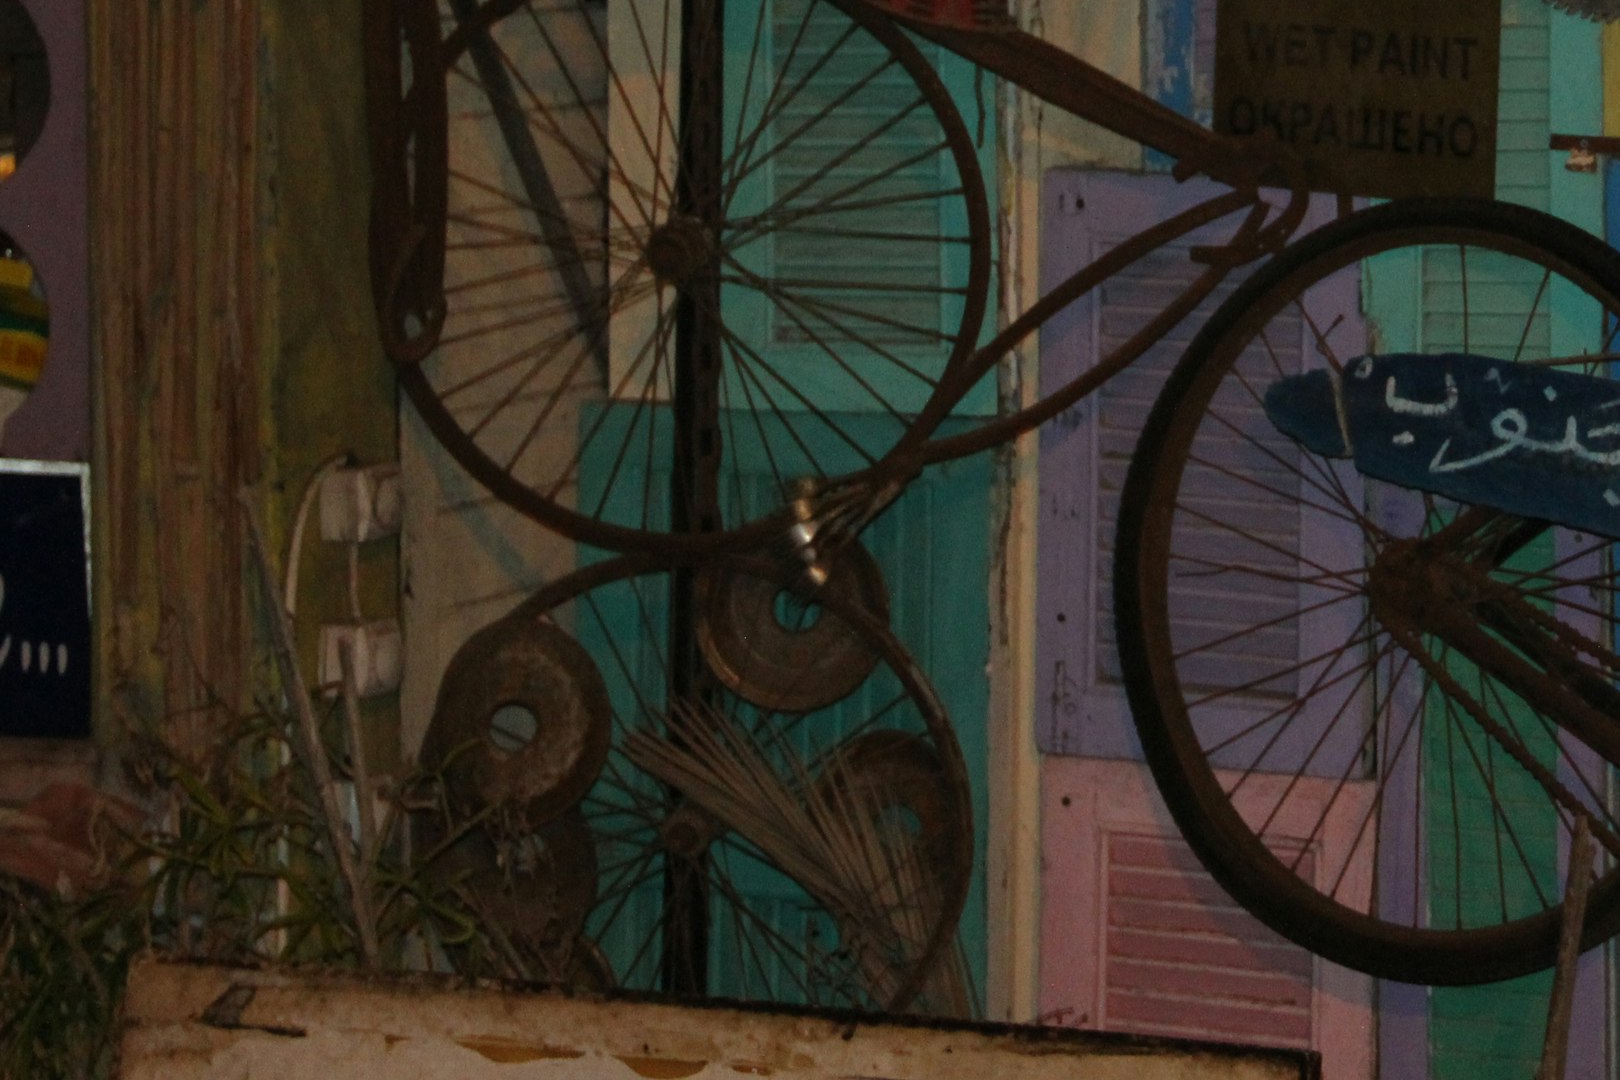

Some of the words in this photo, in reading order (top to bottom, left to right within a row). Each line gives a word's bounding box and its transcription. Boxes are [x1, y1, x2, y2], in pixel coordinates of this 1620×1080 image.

[1244, 21, 1336, 68] WET
[1350, 28, 1478, 80] PAINT
[1228, 96, 1479, 158] ОКРАШЕНО
